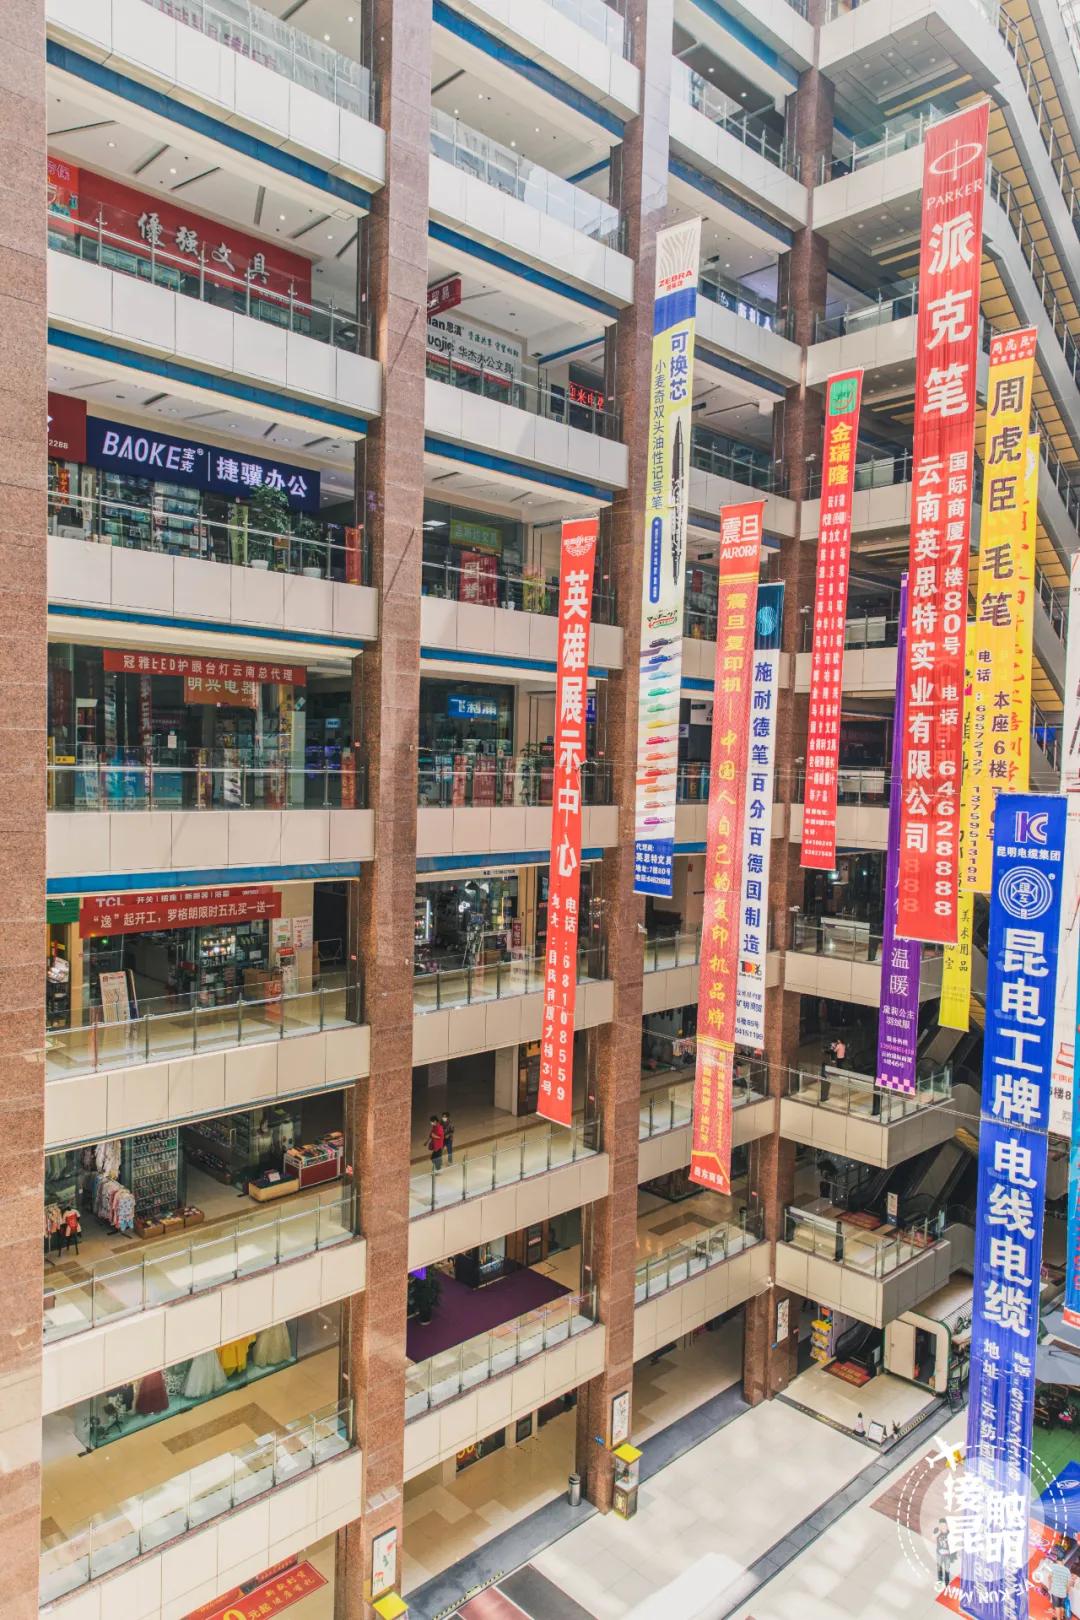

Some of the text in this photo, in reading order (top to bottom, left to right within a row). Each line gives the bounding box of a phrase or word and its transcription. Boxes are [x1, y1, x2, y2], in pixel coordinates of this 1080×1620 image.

[926, 178, 983, 210] PARKER
[658, 269, 693, 287] ZEBRA
[922, 211, 976, 418] 派克笔
[669, 331, 689, 401] 可换芯
[102, 430, 182, 470] BAOKE
[827, 421, 853, 487] 金瑞隆
[721, 514, 759, 545] 震旦
[979, 375, 1024, 627] 周虎臣毛笔
[721, 544, 758, 560] AURORA
[942, 451, 968, 656] 国际商厦7楼80号
[904, 454, 944, 853] 云南英思特实业有限公司
[556, 569, 590, 878] 英雄展示中心
[743, 661, 773, 955] 施耐德笔百分百德国制造
[997, 846, 1061, 862] 昆明电缆集团
